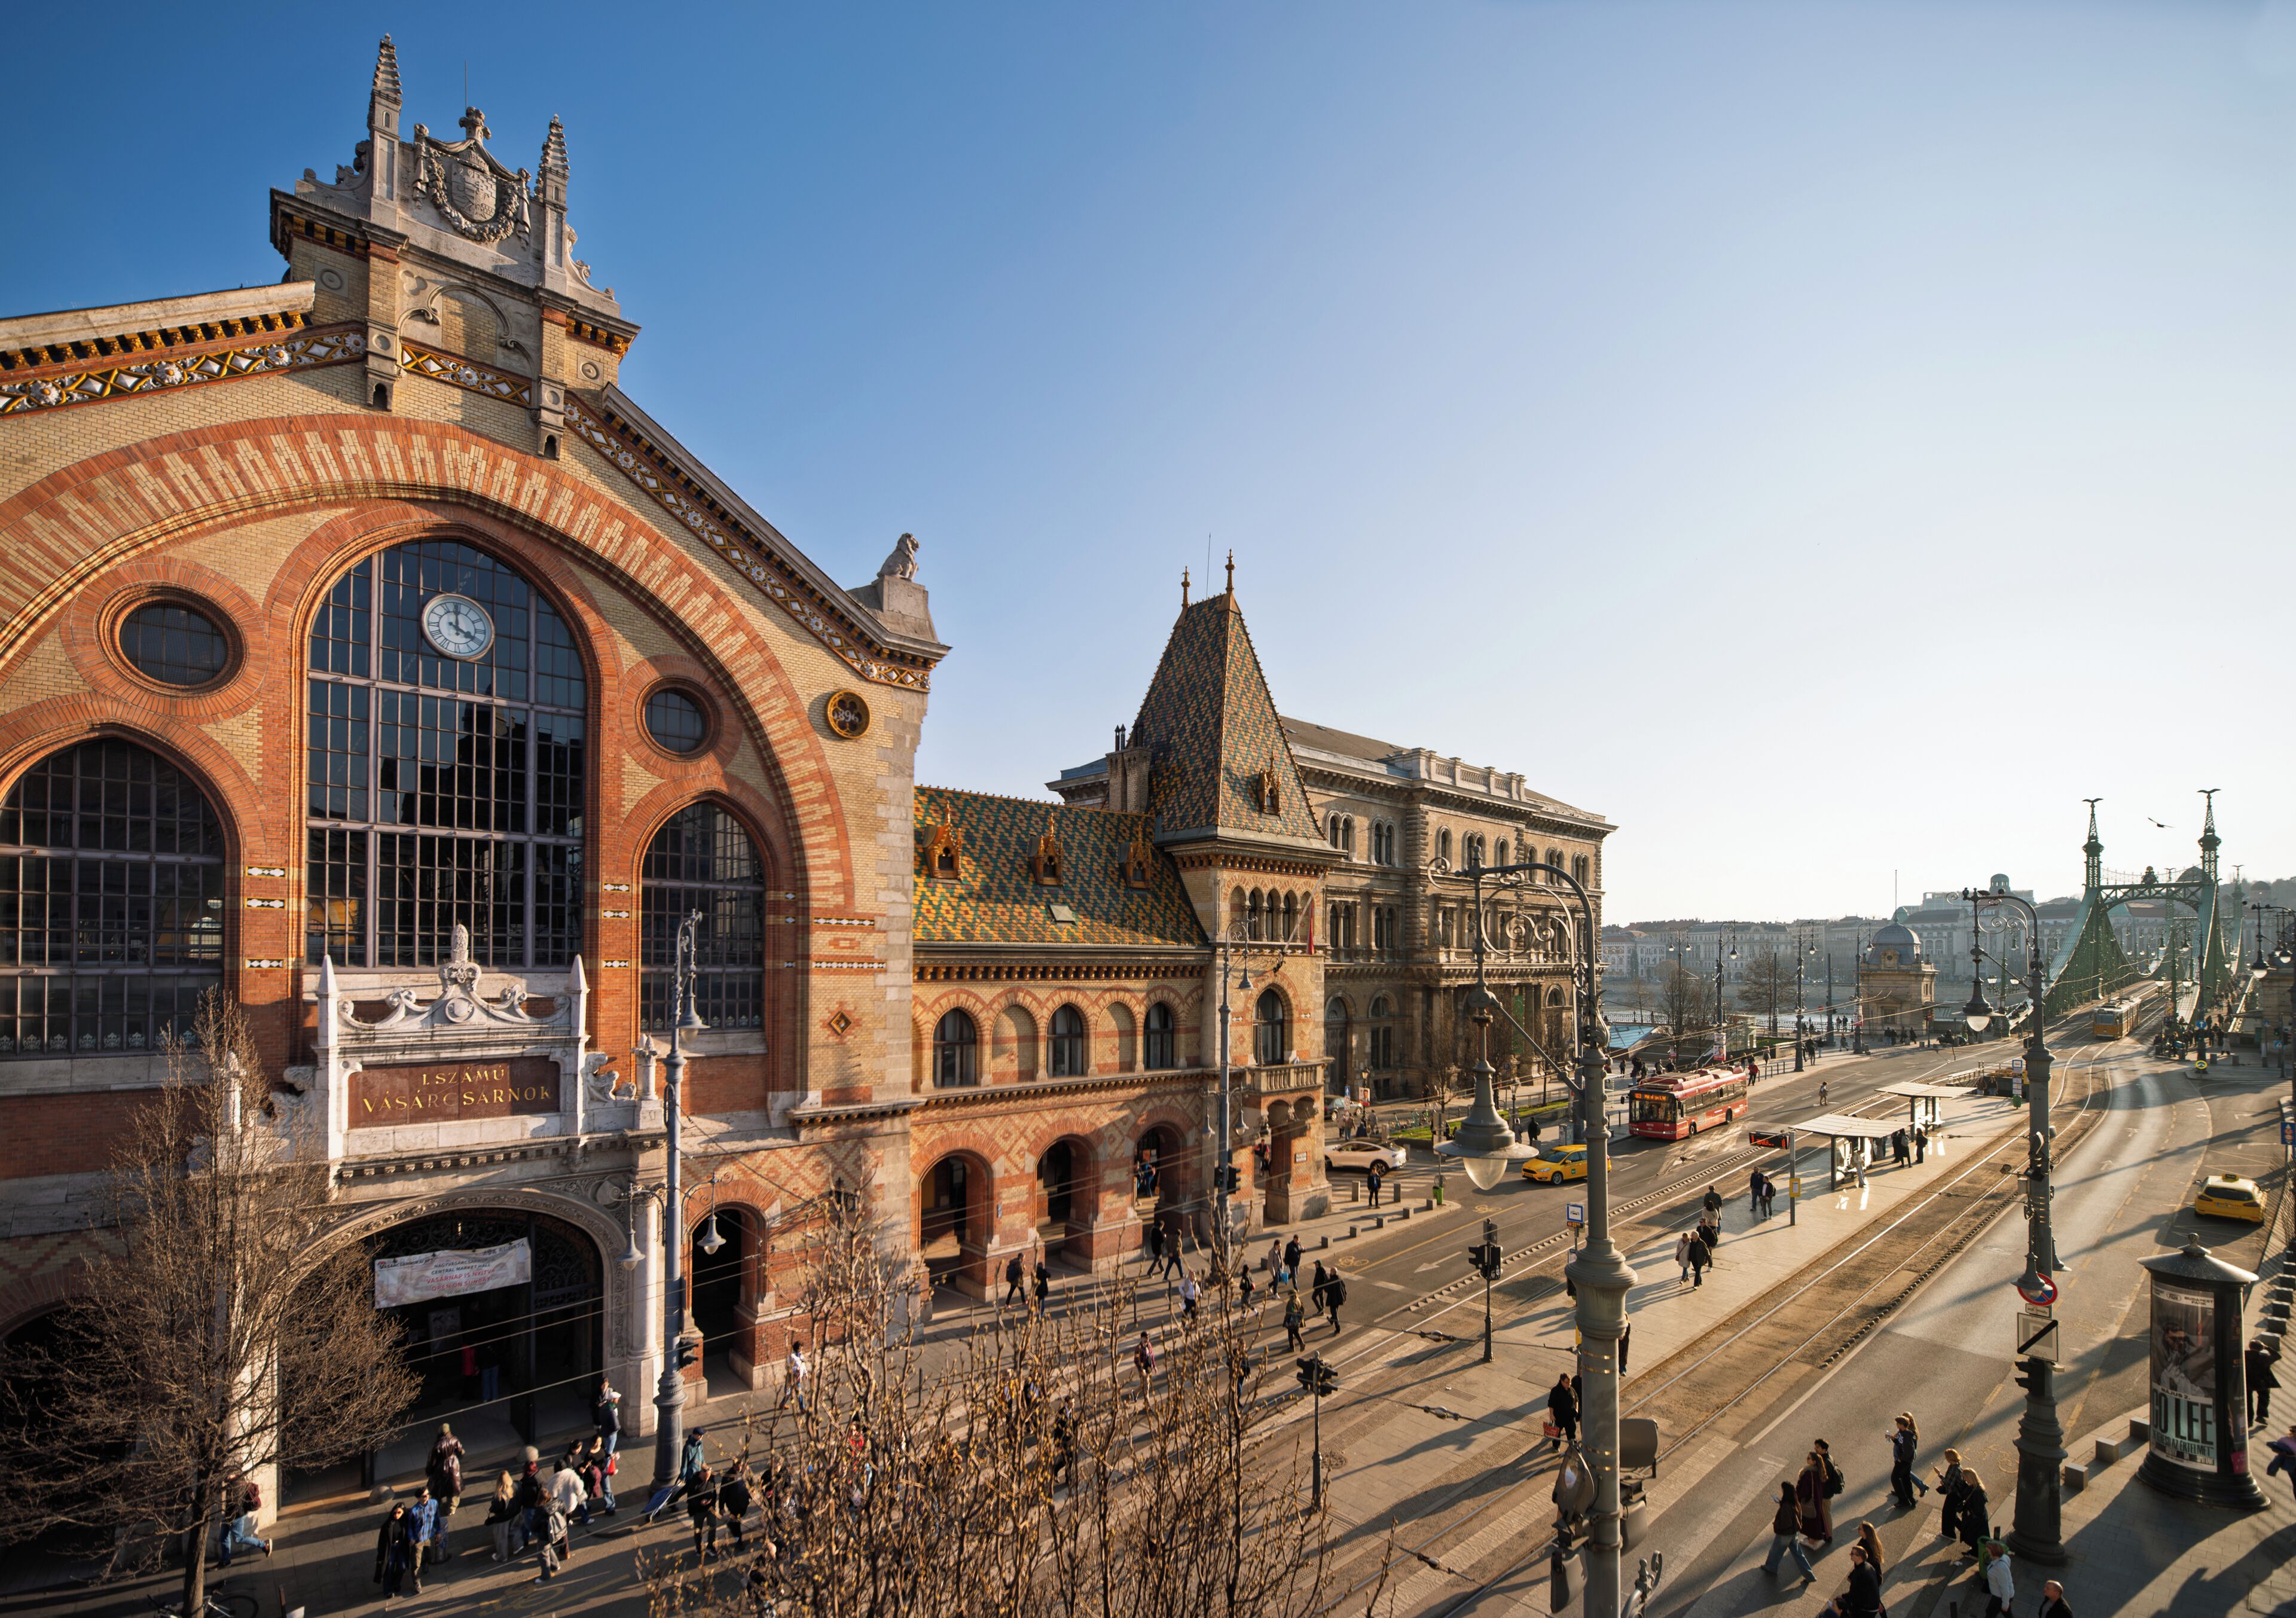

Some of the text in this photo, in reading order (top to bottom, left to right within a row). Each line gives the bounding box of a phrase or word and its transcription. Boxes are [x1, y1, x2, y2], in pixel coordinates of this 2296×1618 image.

[435, 1065, 505, 1085] SZÁMÚ
[2161, 1387, 2183, 1398] MÁJUS
[2175, 1397, 2213, 1445] LEE
